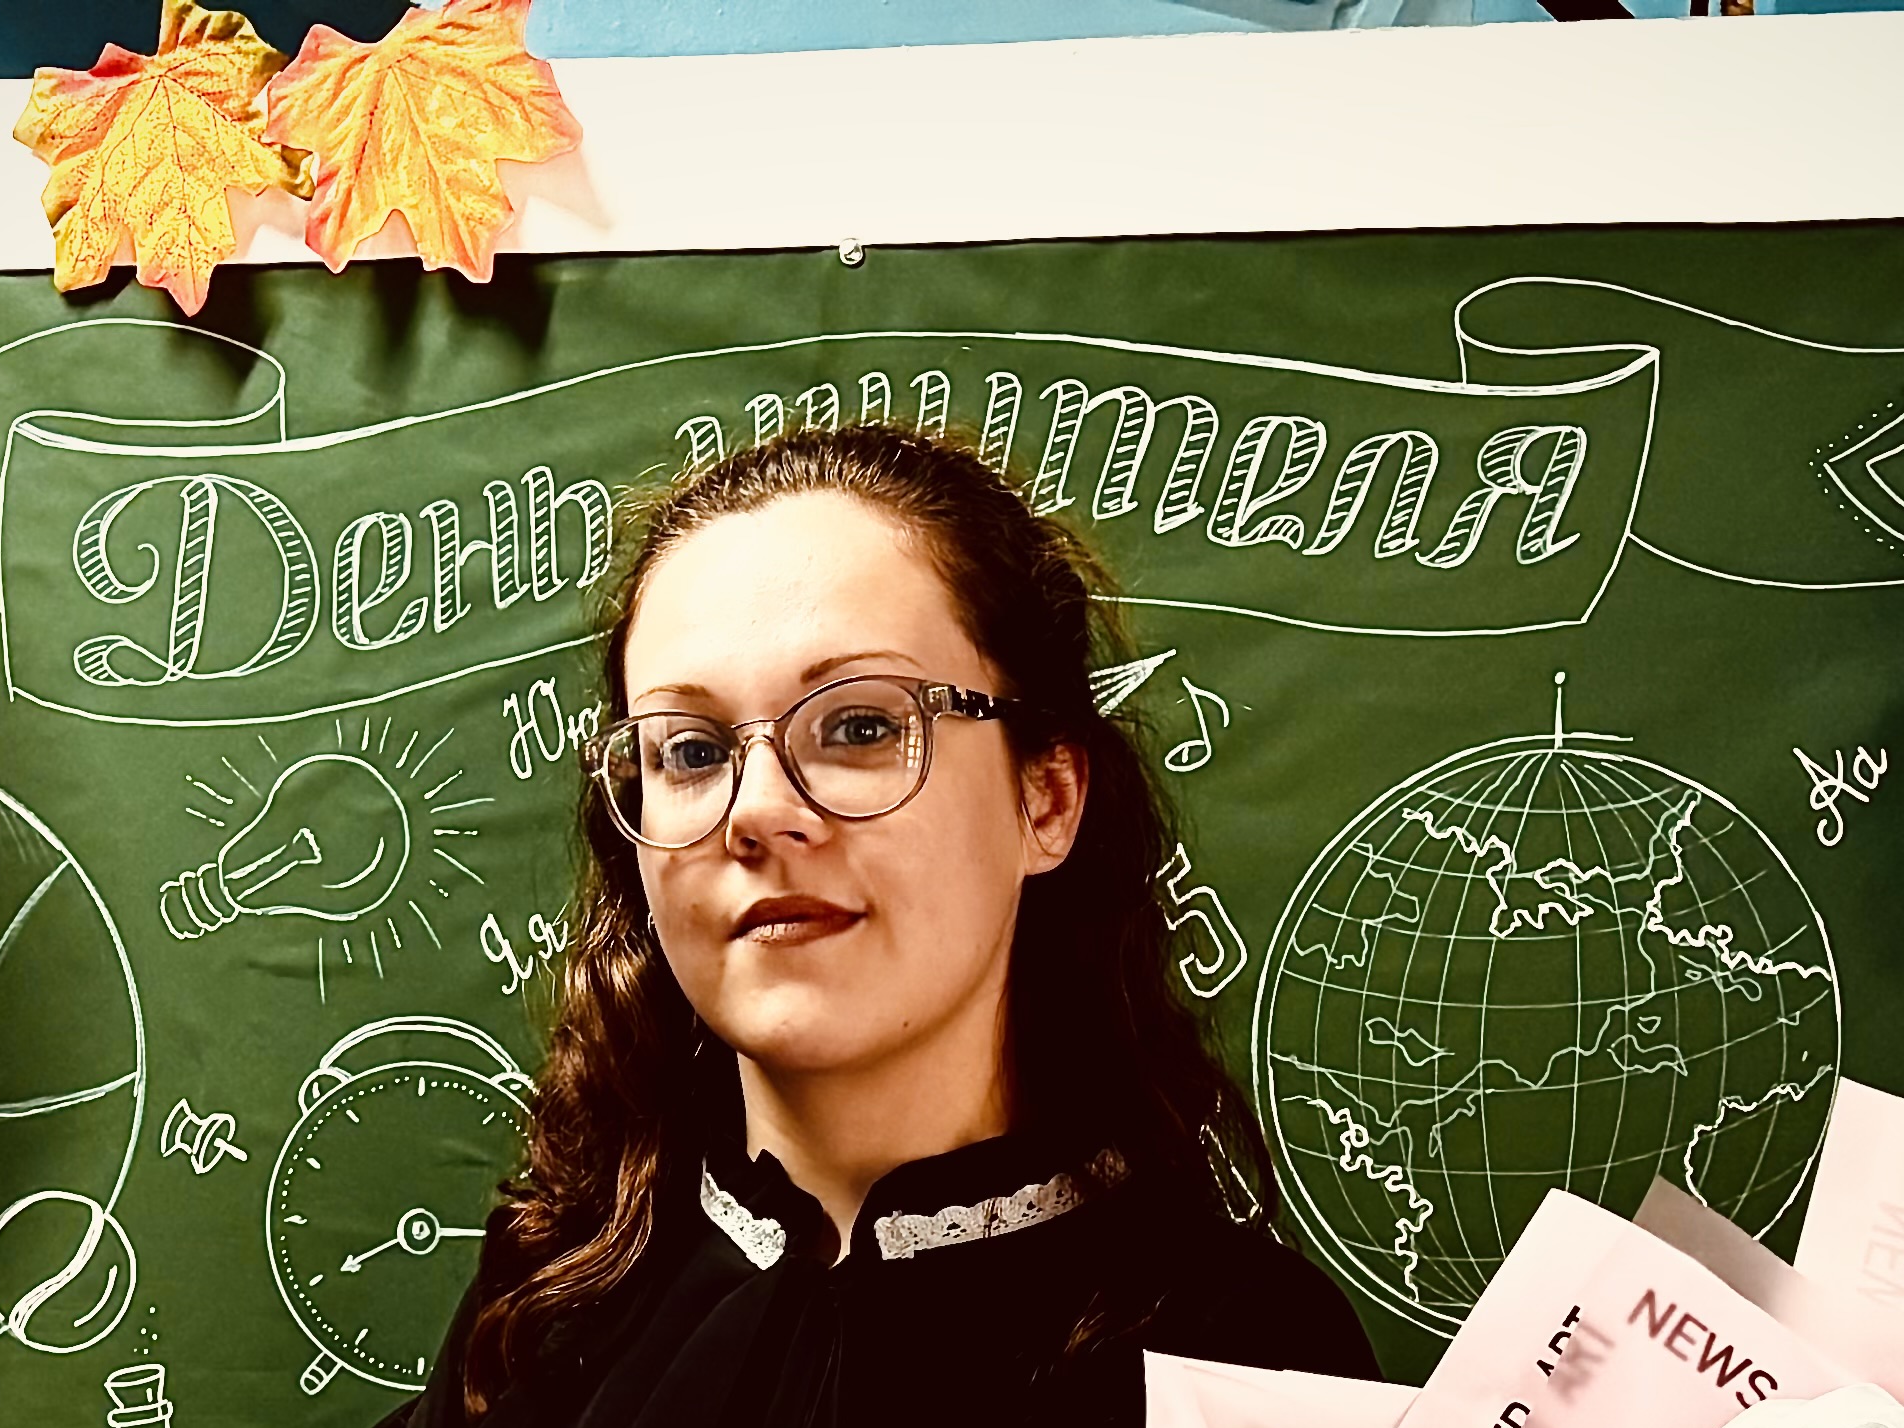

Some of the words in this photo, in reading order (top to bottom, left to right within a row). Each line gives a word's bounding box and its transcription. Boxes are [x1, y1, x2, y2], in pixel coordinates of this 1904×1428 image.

[73, 465, 614, 686] День
[674, 370, 1587, 568] теля
[1626, 1288, 1781, 1410] NEWS
